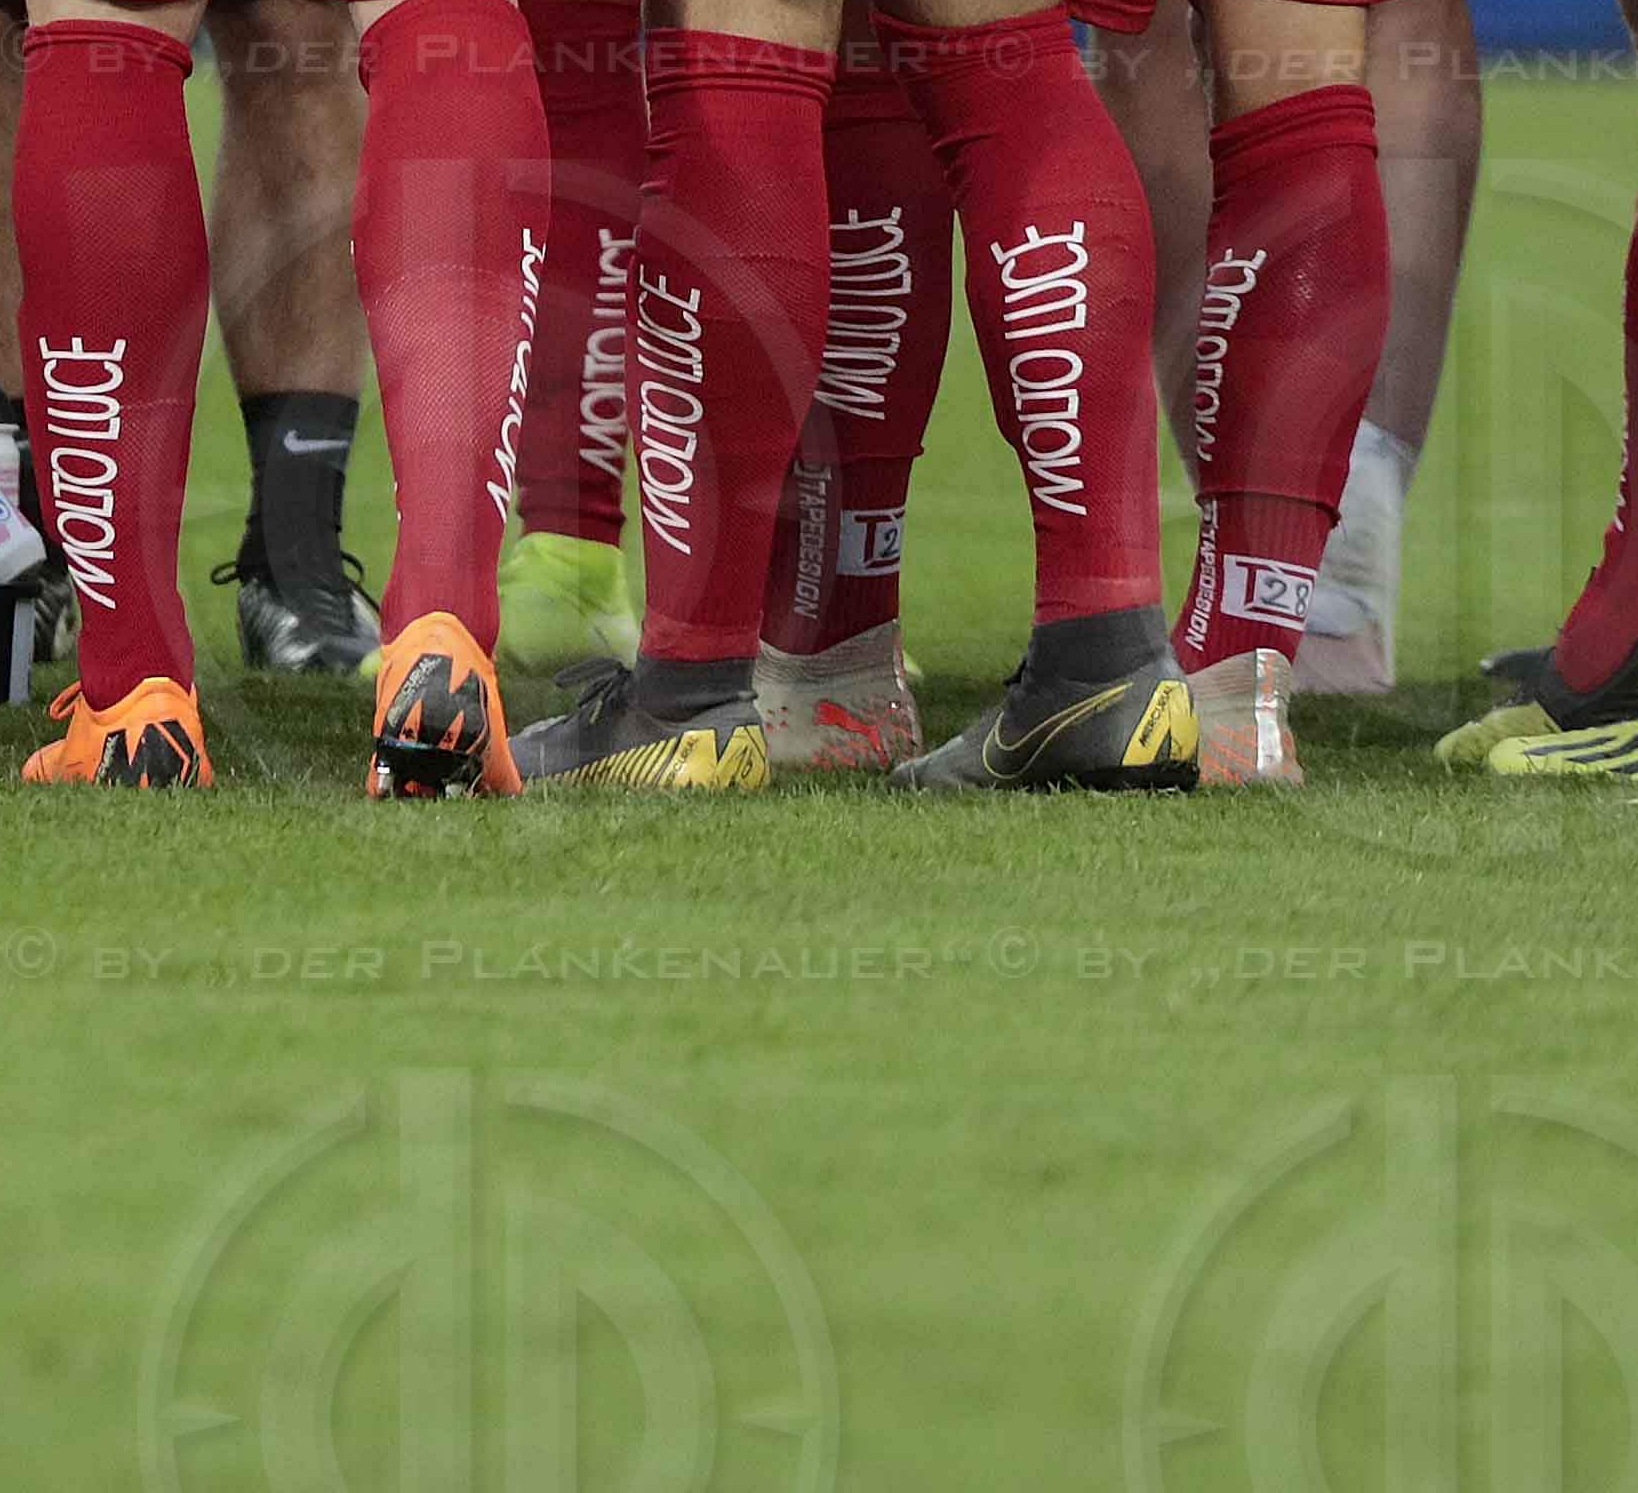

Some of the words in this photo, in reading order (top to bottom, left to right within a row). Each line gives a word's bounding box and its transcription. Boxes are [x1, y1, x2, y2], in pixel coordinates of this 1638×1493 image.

[637, 269, 702, 389] LUCE
[991, 220, 1089, 339] LUCE
[38, 335, 127, 441] LUCE
[1003, 347, 1087, 518] MOLTO
[51, 442, 118, 611] MOLTO
[638, 385, 700, 556] MOLTO
